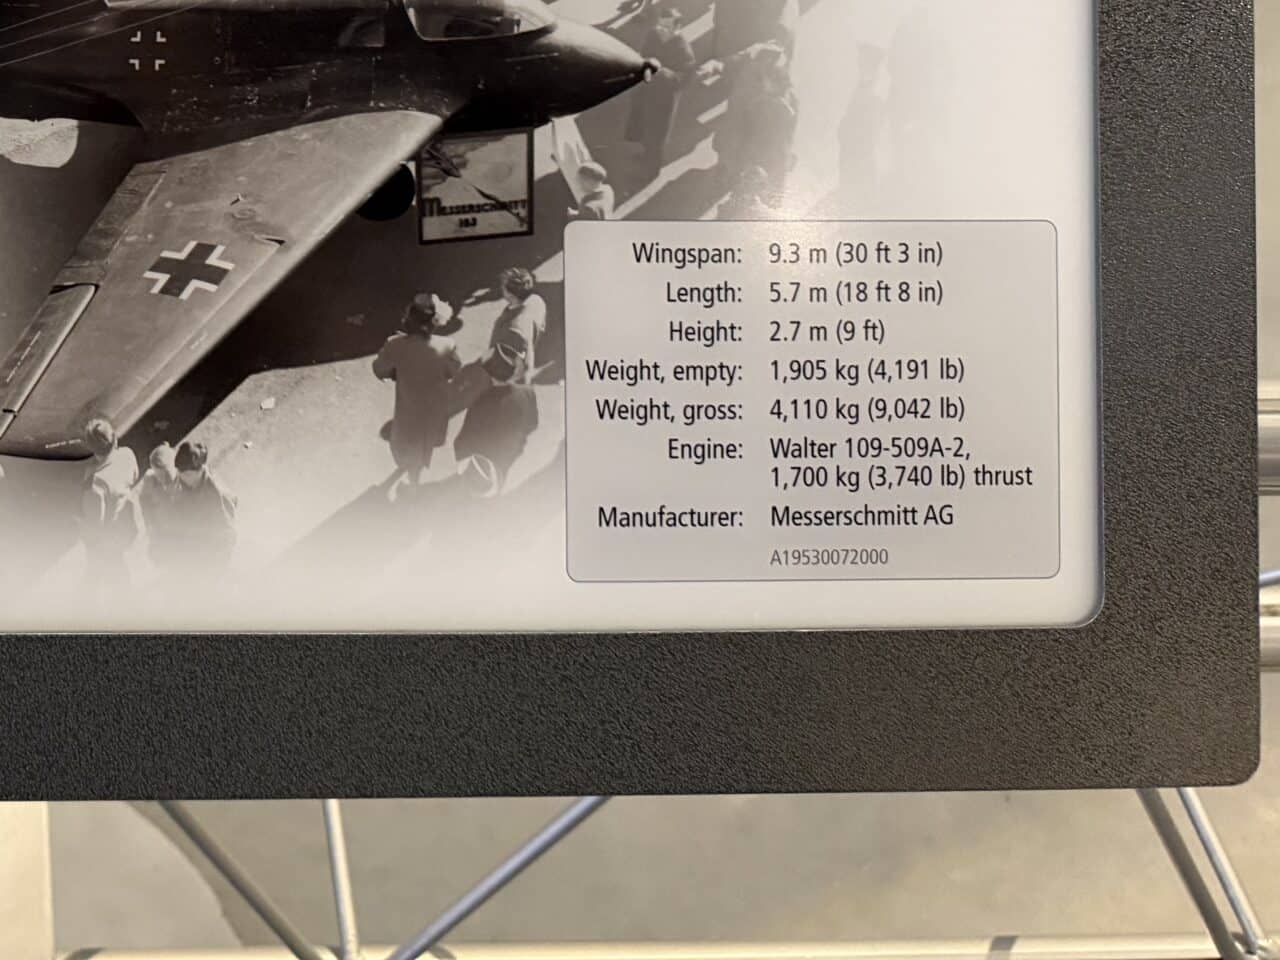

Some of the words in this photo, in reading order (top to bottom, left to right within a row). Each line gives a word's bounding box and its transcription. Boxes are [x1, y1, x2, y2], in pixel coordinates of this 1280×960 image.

[632, 242, 742, 270] Wingspan:
[769, 243, 800, 263] 9.3
[809, 248, 827, 264] m
[836, 241, 868, 267] (30
[875, 241, 892, 263] ft
[898, 242, 909, 263] 3
[918, 241, 943, 267] in)
[667, 280, 742, 309] Length:
[770, 282, 800, 303] 5.7
[809, 287, 827, 303] m
[836, 280, 868, 306] (18
[875, 280, 892, 302] ft
[898, 281, 910, 302] 8
[918, 280, 943, 306] in)
[669, 320, 742, 348] Height:
[769, 320, 801, 342] 2.7
[809, 326, 827, 342] m
[836, 319, 855, 345] (9
[862, 319, 885, 345] ft)
[585, 358, 665, 387] Weight,
[673, 362, 742, 387] empty:
[771, 360, 827, 384] 1,905
[835, 358, 859, 386] kg
[868, 358, 928, 384] (4,191
[940, 357, 964, 383] lb)
[595, 397, 675, 426] Weight,
[683, 404, 743, 426] gross:
[769, 398, 828, 423] 4,110
[836, 397, 859, 425] kg
[868, 397, 931, 423] (9,042
[940, 396, 965, 422] lb)
[668, 437, 743, 465] Engine:
[769, 436, 837, 459] Walter
[845, 437, 970, 461] 109-509A-2,
[771, 466, 828, 491] 1,700
[836, 464, 860, 493] kg
[868, 465, 932, 491] (3,740
[941, 464, 965, 490] lb)
[973, 464, 1033, 486] thrust
[598, 504, 743, 528] Manufacturer:
[771, 504, 918, 527] Messerschmitt
[923, 504, 953, 525] AG
[770, 549, 888, 566] A19530072000
